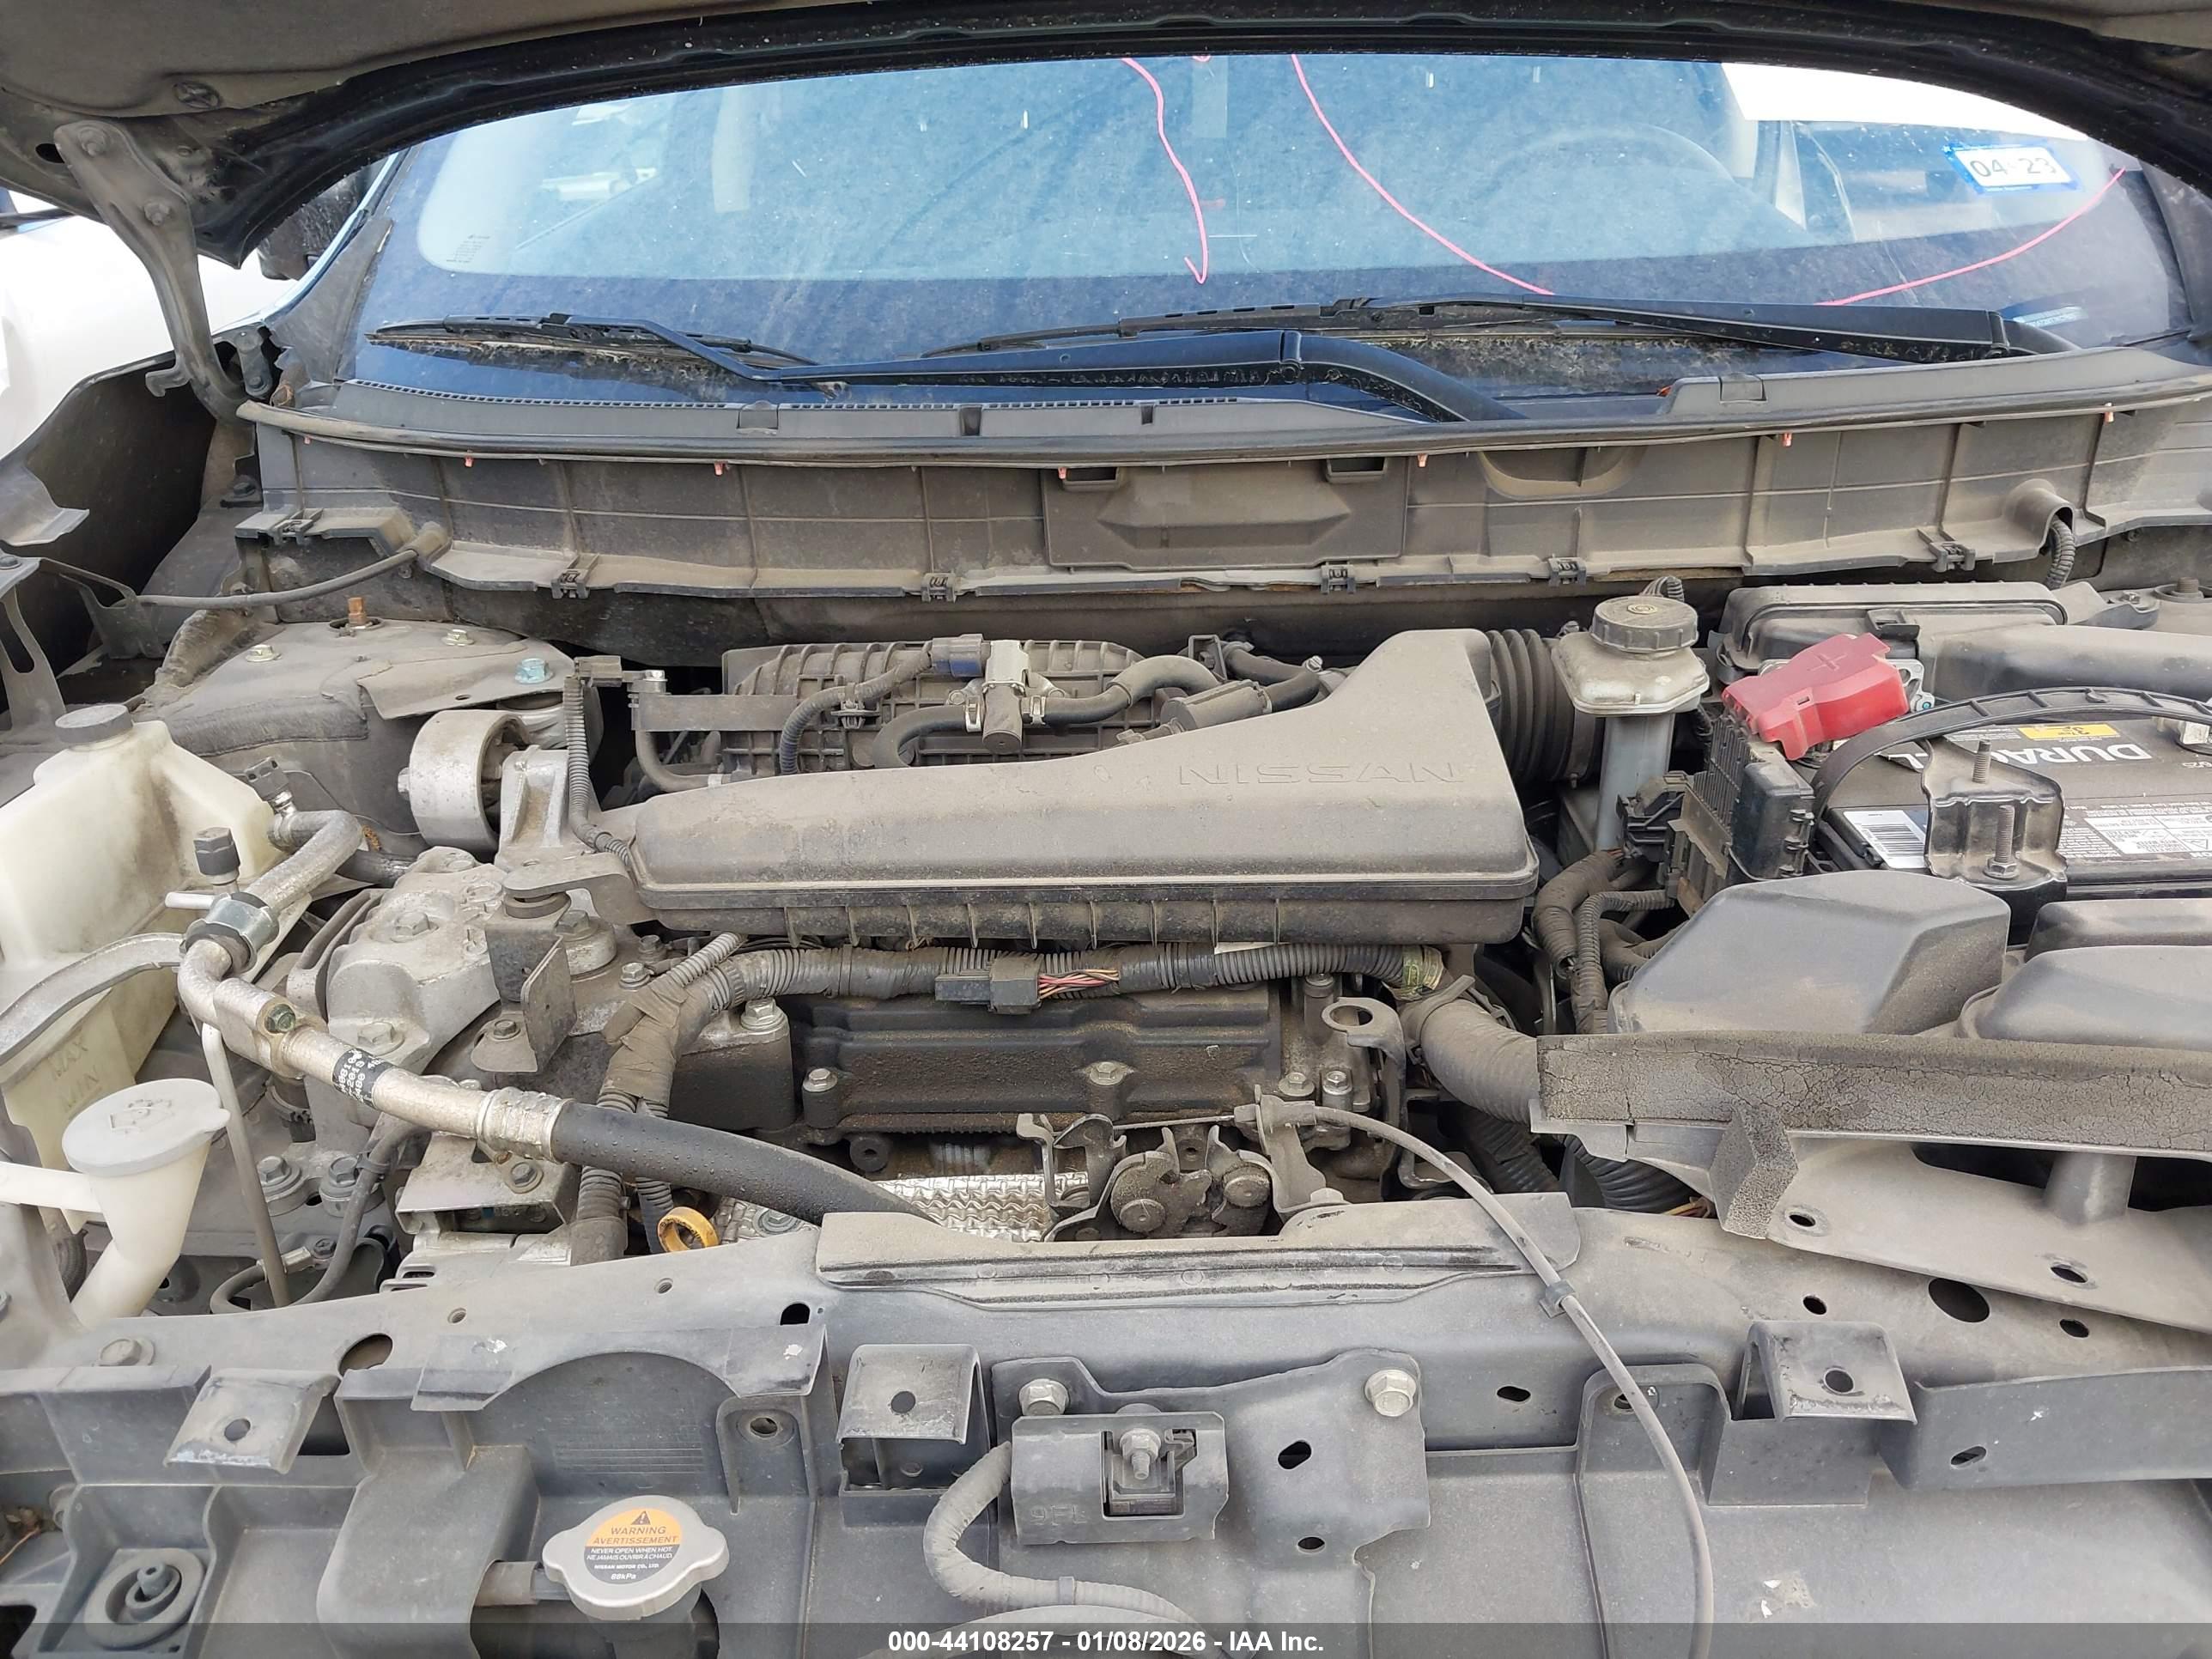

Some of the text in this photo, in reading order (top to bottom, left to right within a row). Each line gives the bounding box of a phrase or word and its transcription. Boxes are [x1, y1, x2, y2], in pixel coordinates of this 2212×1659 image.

[1969, 157, 2057, 178] 04 23
[1179, 762, 1463, 785] NISSAN
[611, 1526, 667, 1535] WARNING
[592, 1535, 678, 1545] AVERTISSEMENT
